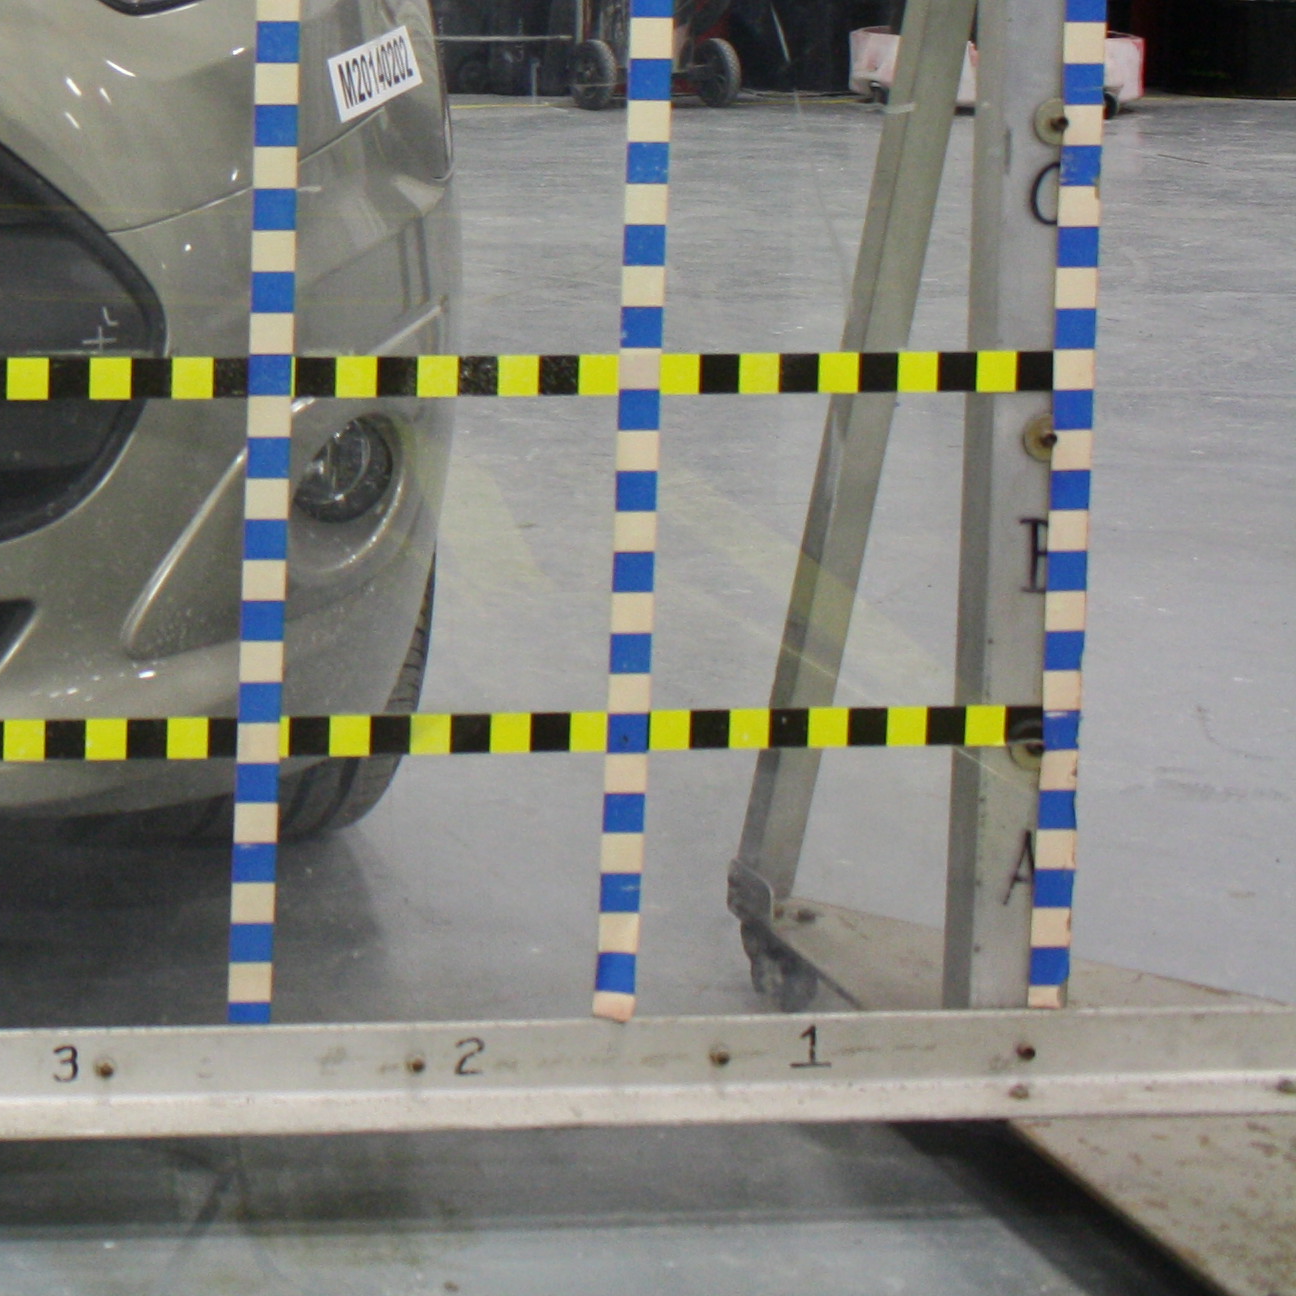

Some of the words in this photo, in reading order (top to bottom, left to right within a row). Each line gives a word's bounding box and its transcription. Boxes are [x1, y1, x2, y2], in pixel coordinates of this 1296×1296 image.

[337, 35, 414, 110] M20140202
[53, 1045, 80, 1083] 3
[454, 1036, 486, 1075] 2
[788, 1024, 832, 1068] 1
